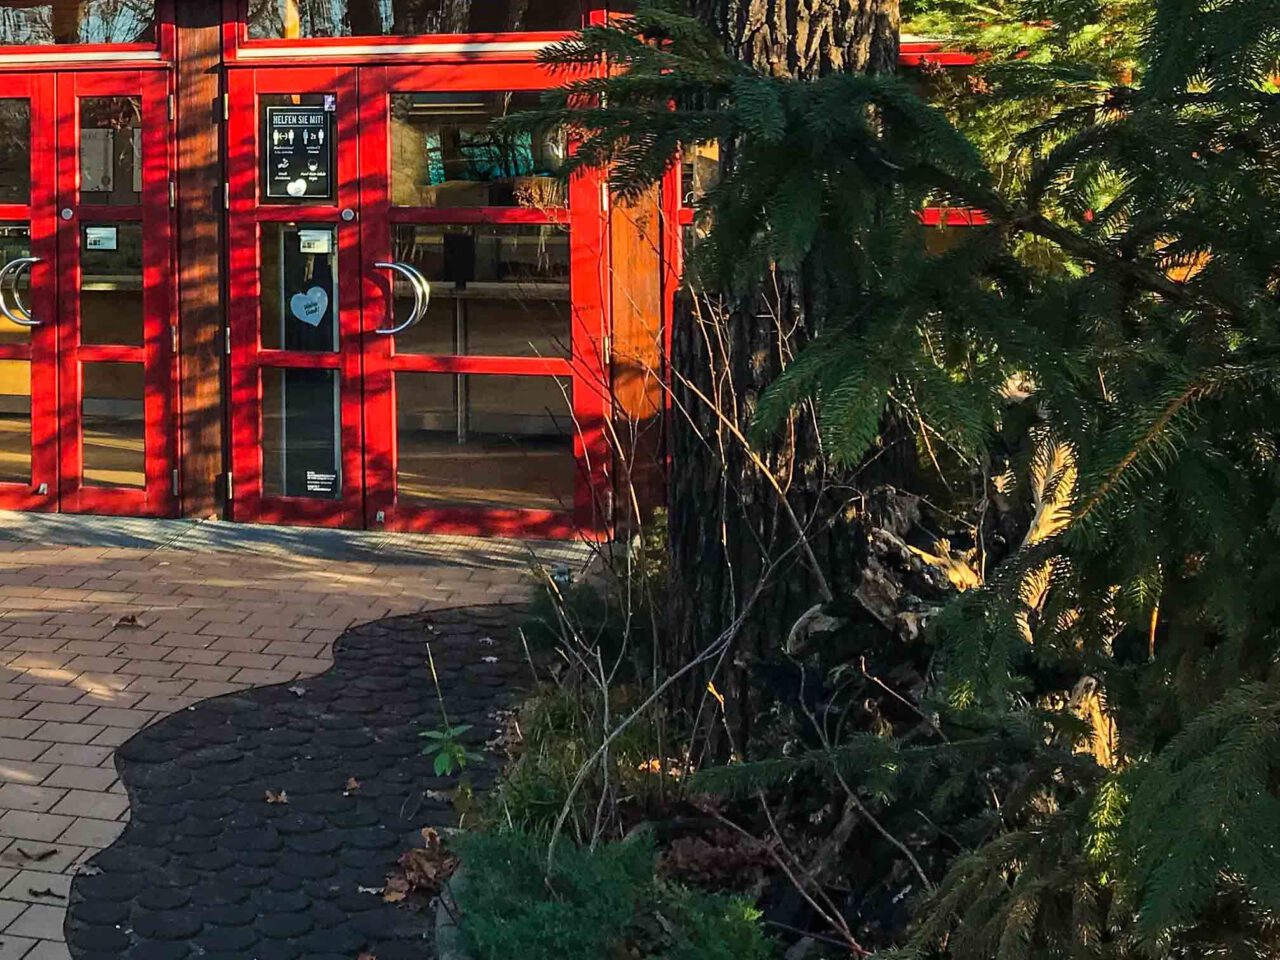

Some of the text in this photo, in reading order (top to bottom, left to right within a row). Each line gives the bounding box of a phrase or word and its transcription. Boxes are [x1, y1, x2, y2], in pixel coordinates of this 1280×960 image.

[273, 115, 324, 124] HELFEN SIE MIT!
